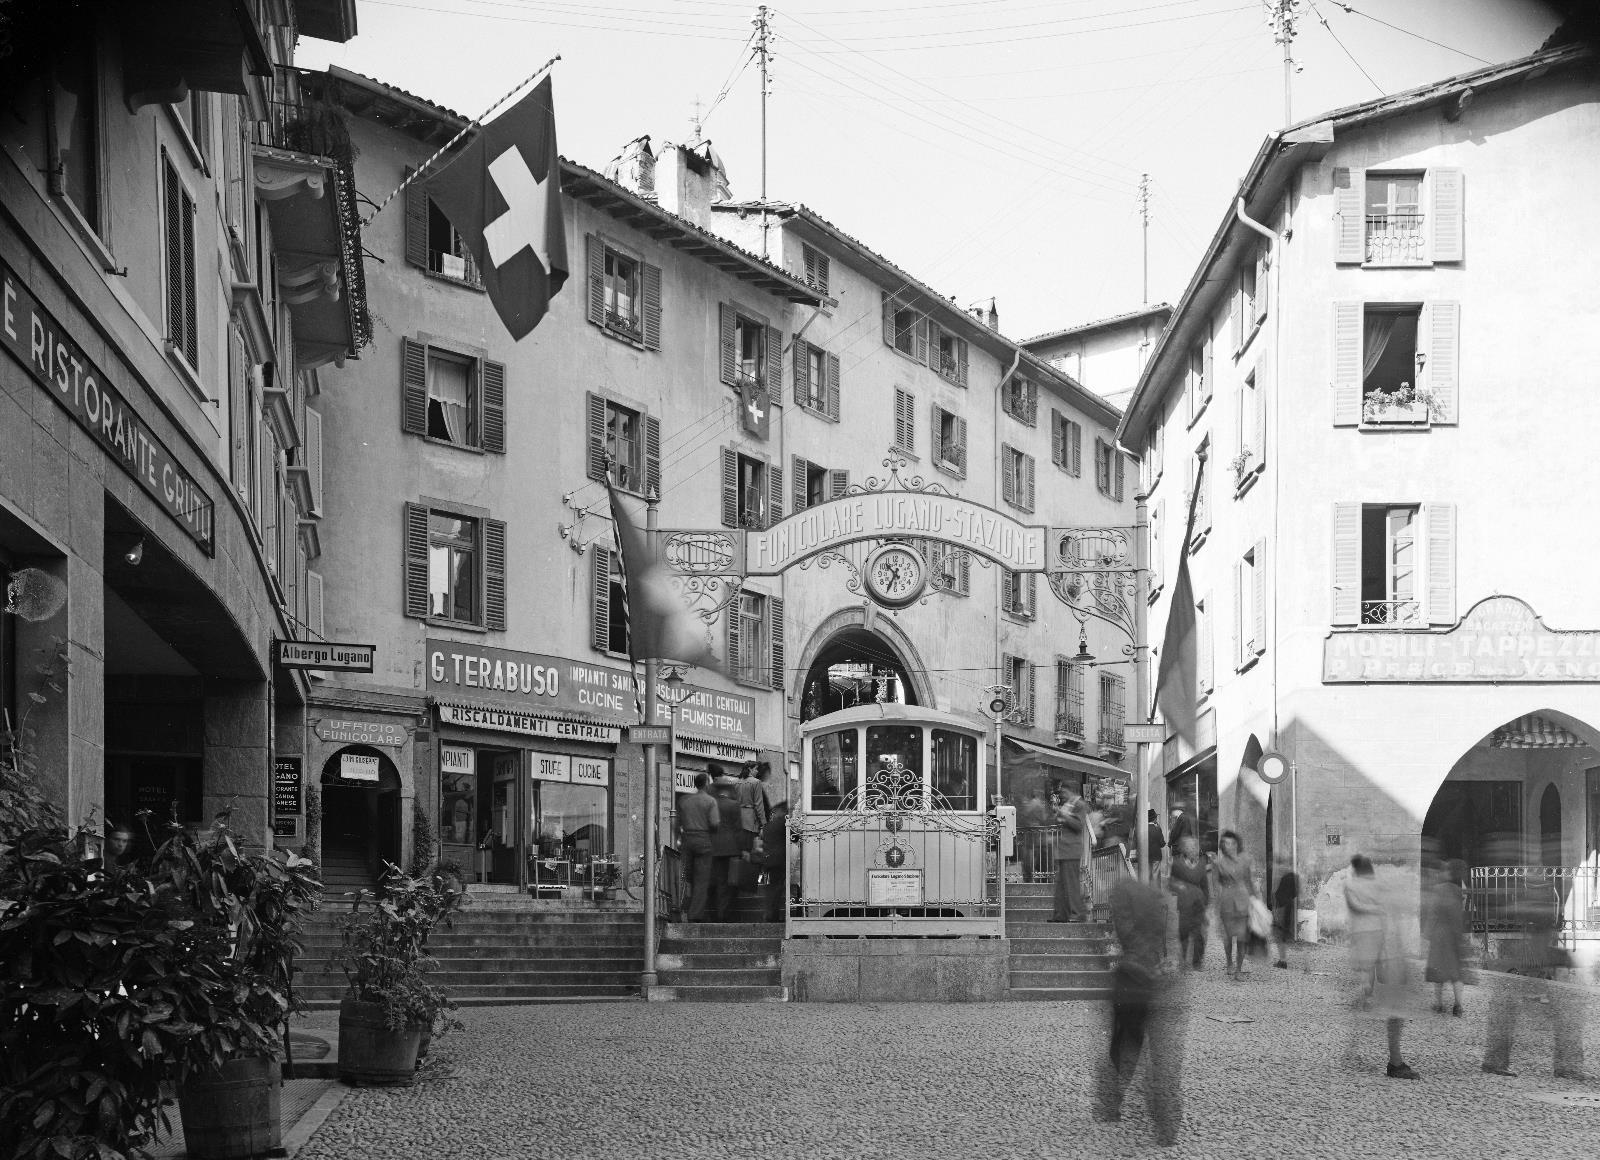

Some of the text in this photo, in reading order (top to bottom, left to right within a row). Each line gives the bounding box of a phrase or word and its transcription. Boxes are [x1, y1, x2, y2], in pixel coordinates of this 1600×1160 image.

[31, 311, 157, 487] RISTORANTE
[162, 462, 212, 543] GRÜTLI
[757, 500, 865, 568] FUNICOLARE
[282, 644, 370, 665] Albergo Lugano
[451, 654, 559, 697] TERABUSO
[569, 666, 608, 688] IMPIANTI
[656, 683, 713, 708] ISCALDAMENTI
[716, 696, 751, 716] CENTRALI
[578, 689, 624, 711] CUCINE
[681, 708, 743, 733] FUMISTERIA
[330, 721, 395, 735] UFFICIO
[421, 717, 427, 726] 7
[452, 708, 610, 740] RISCALDAMENTI CENTRALI
[323, 730, 401, 745] FUNICOLARE
[633, 729, 668, 740] ENTRATA
[1129, 727, 1161, 738] USCITA
[540, 758, 563, 777] STUFE
[577, 763, 603, 780] CUCINE
